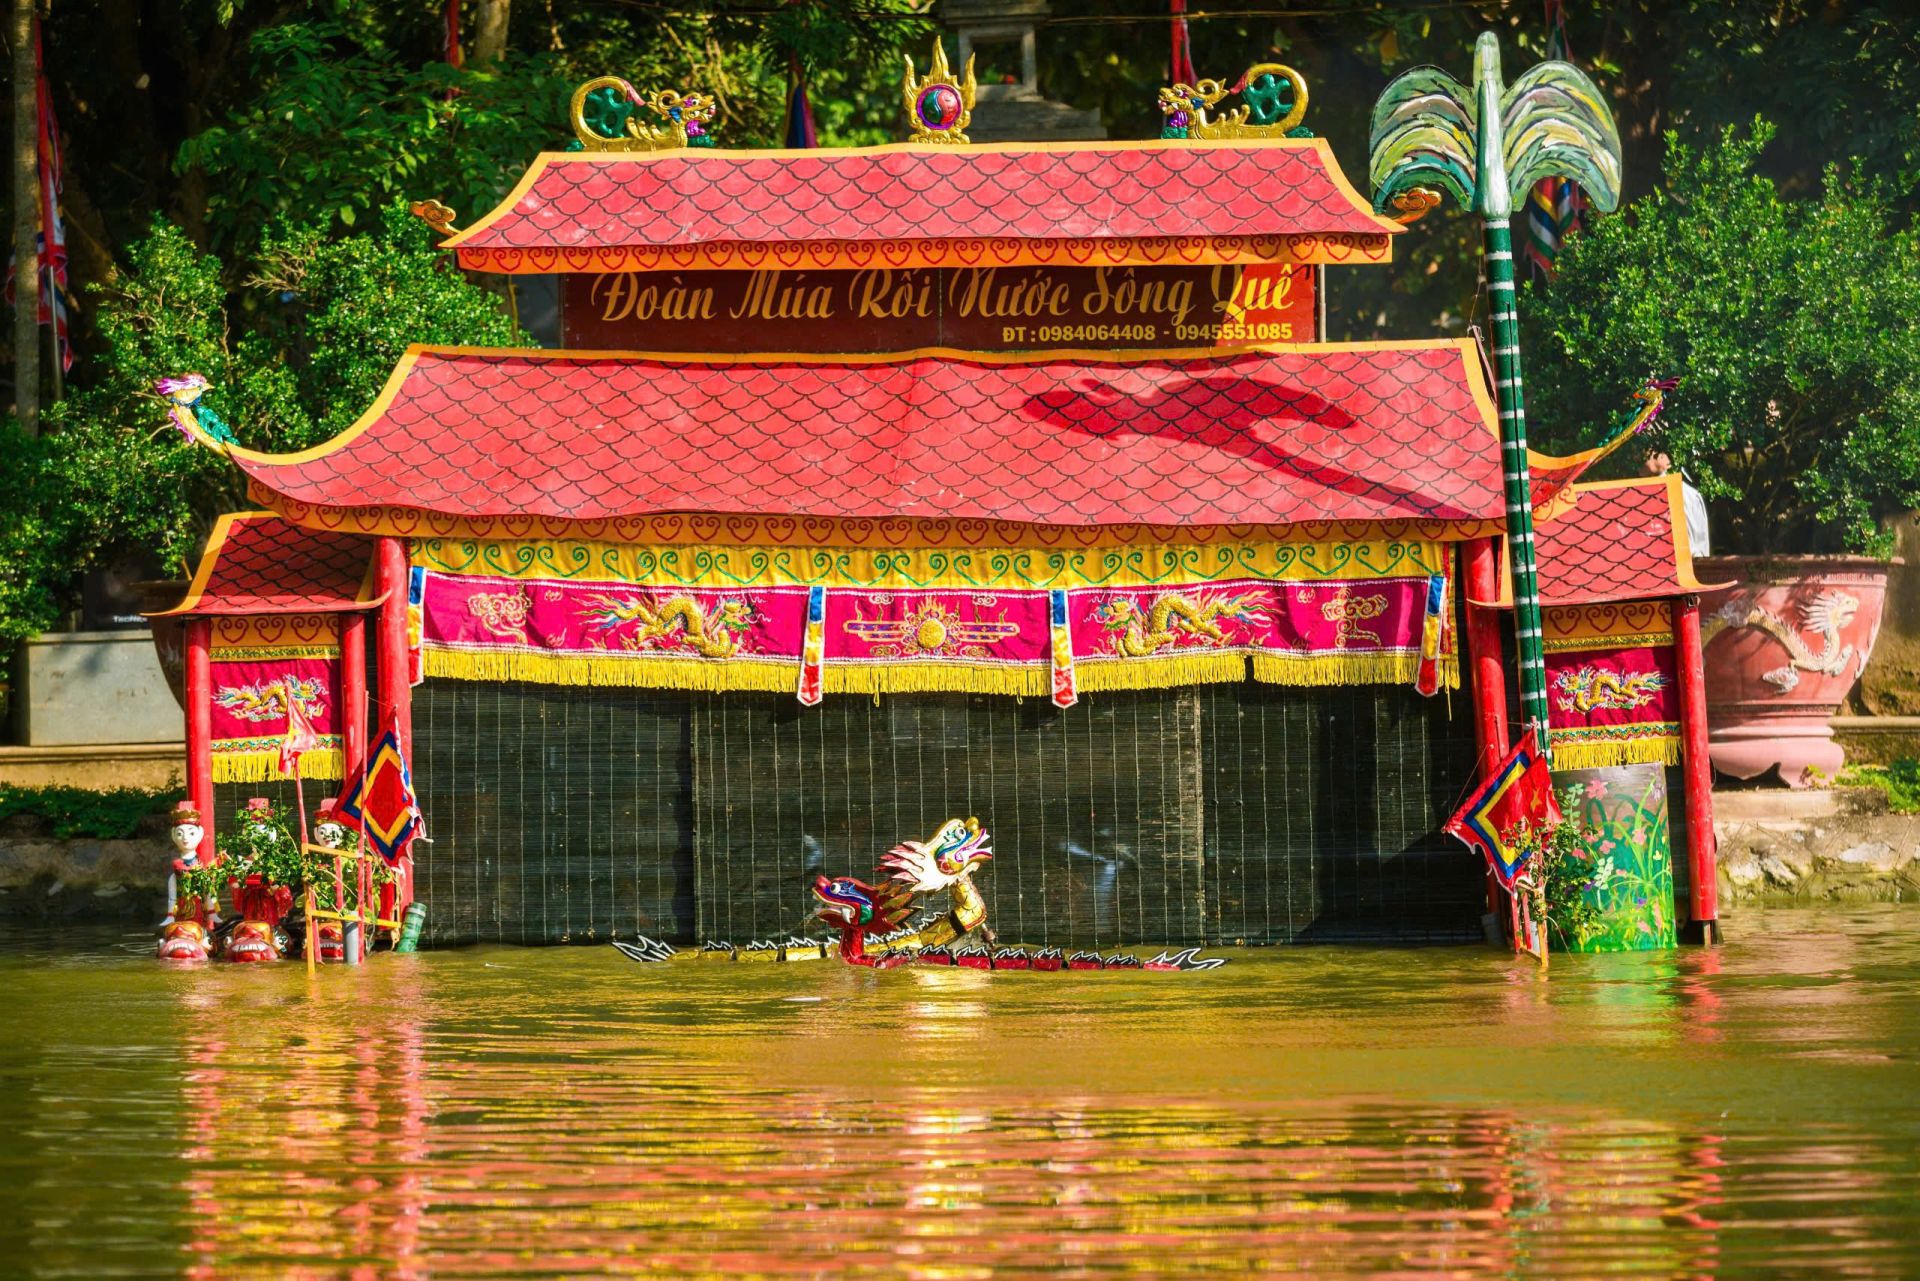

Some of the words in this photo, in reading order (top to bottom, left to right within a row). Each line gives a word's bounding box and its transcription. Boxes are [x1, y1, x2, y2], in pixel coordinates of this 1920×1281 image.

[591, 272, 717, 320] Đoàn
[729, 269, 835, 319] Múa
[848, 268, 934, 318] Rối
[949, 267, 1070, 317] Nước
[1083, 265, 1197, 326] Sông
[1211, 263, 1294, 324] Quê
[1175, 323, 1292, 340] 0945551085
